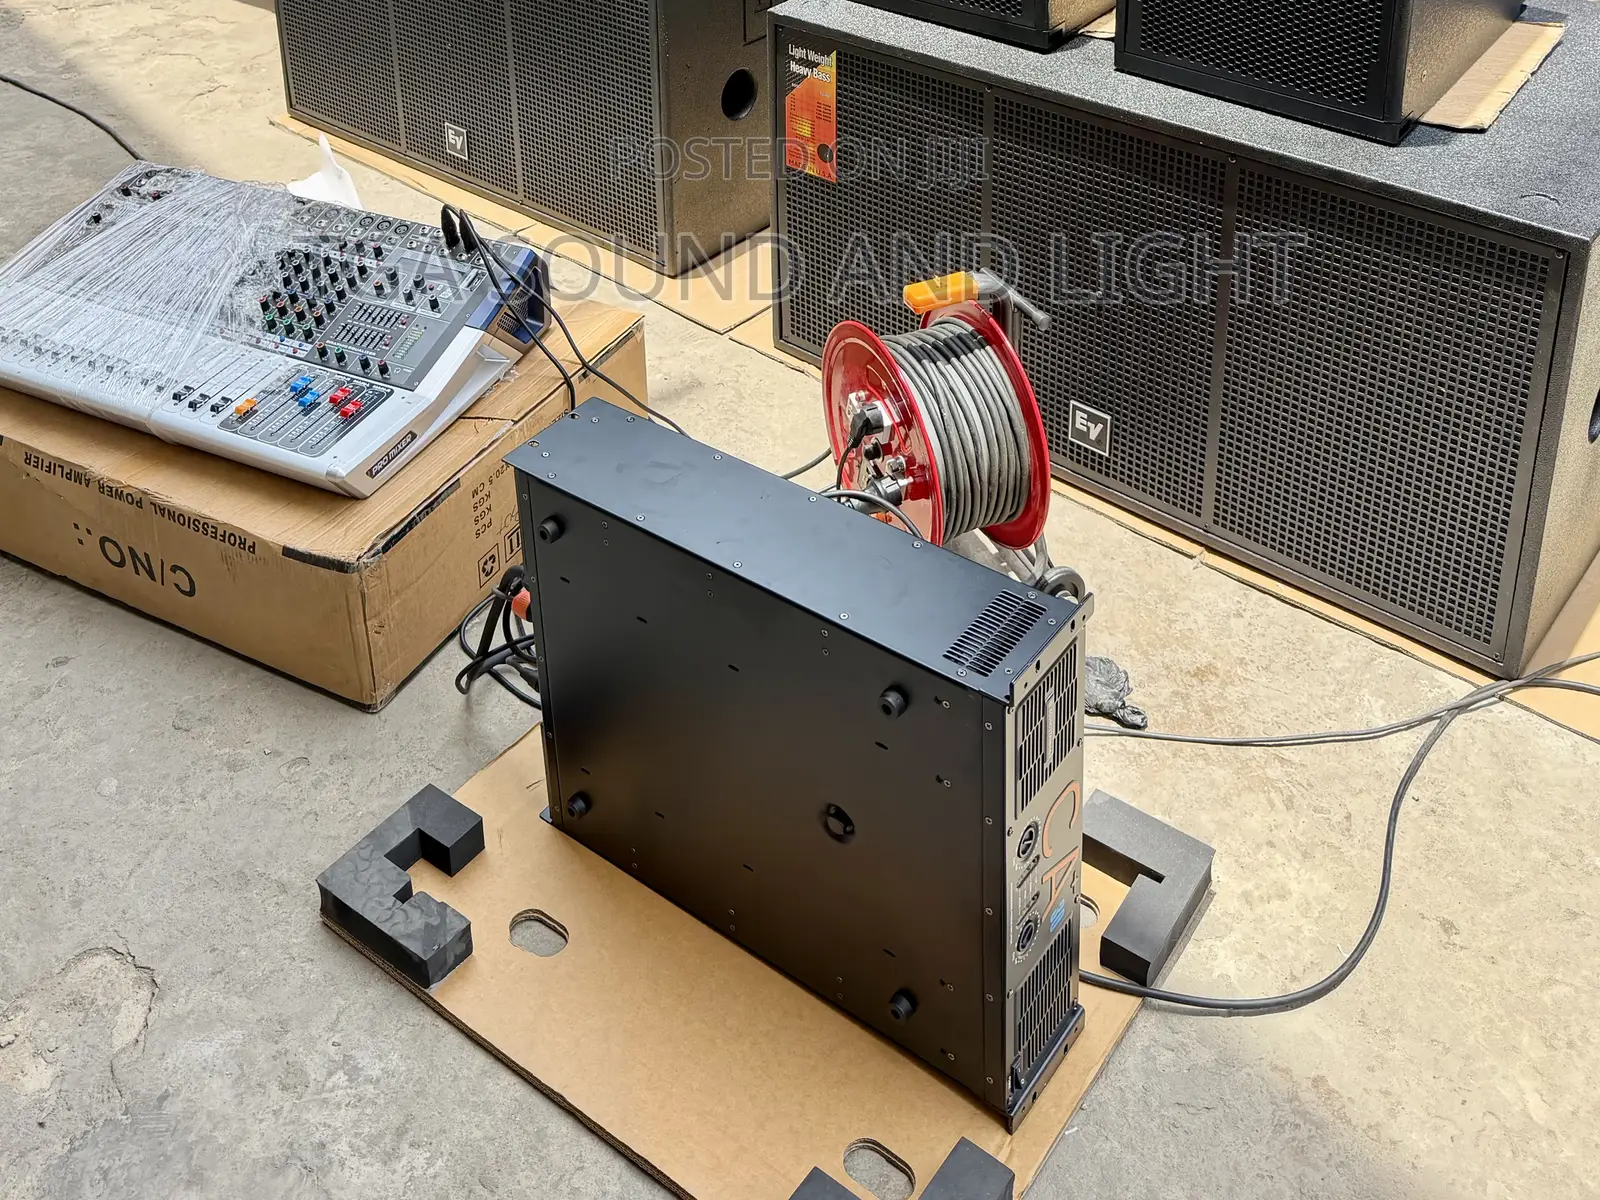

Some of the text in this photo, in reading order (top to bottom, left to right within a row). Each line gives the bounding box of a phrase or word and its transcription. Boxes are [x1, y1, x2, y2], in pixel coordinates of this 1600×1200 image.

[788, 43, 833, 68] Light Weight
[789, 60, 832, 84] Heavy Bass
[371, 433, 413, 476] PRO MIXER
[471, 481, 486, 499] CM
[472, 490, 492, 512] KGS
[23, 451, 257, 555] PROFESSIONAL POWER AMPLIFIER
[473, 503, 493, 526] KGS
[474, 517, 493, 539] PCS
